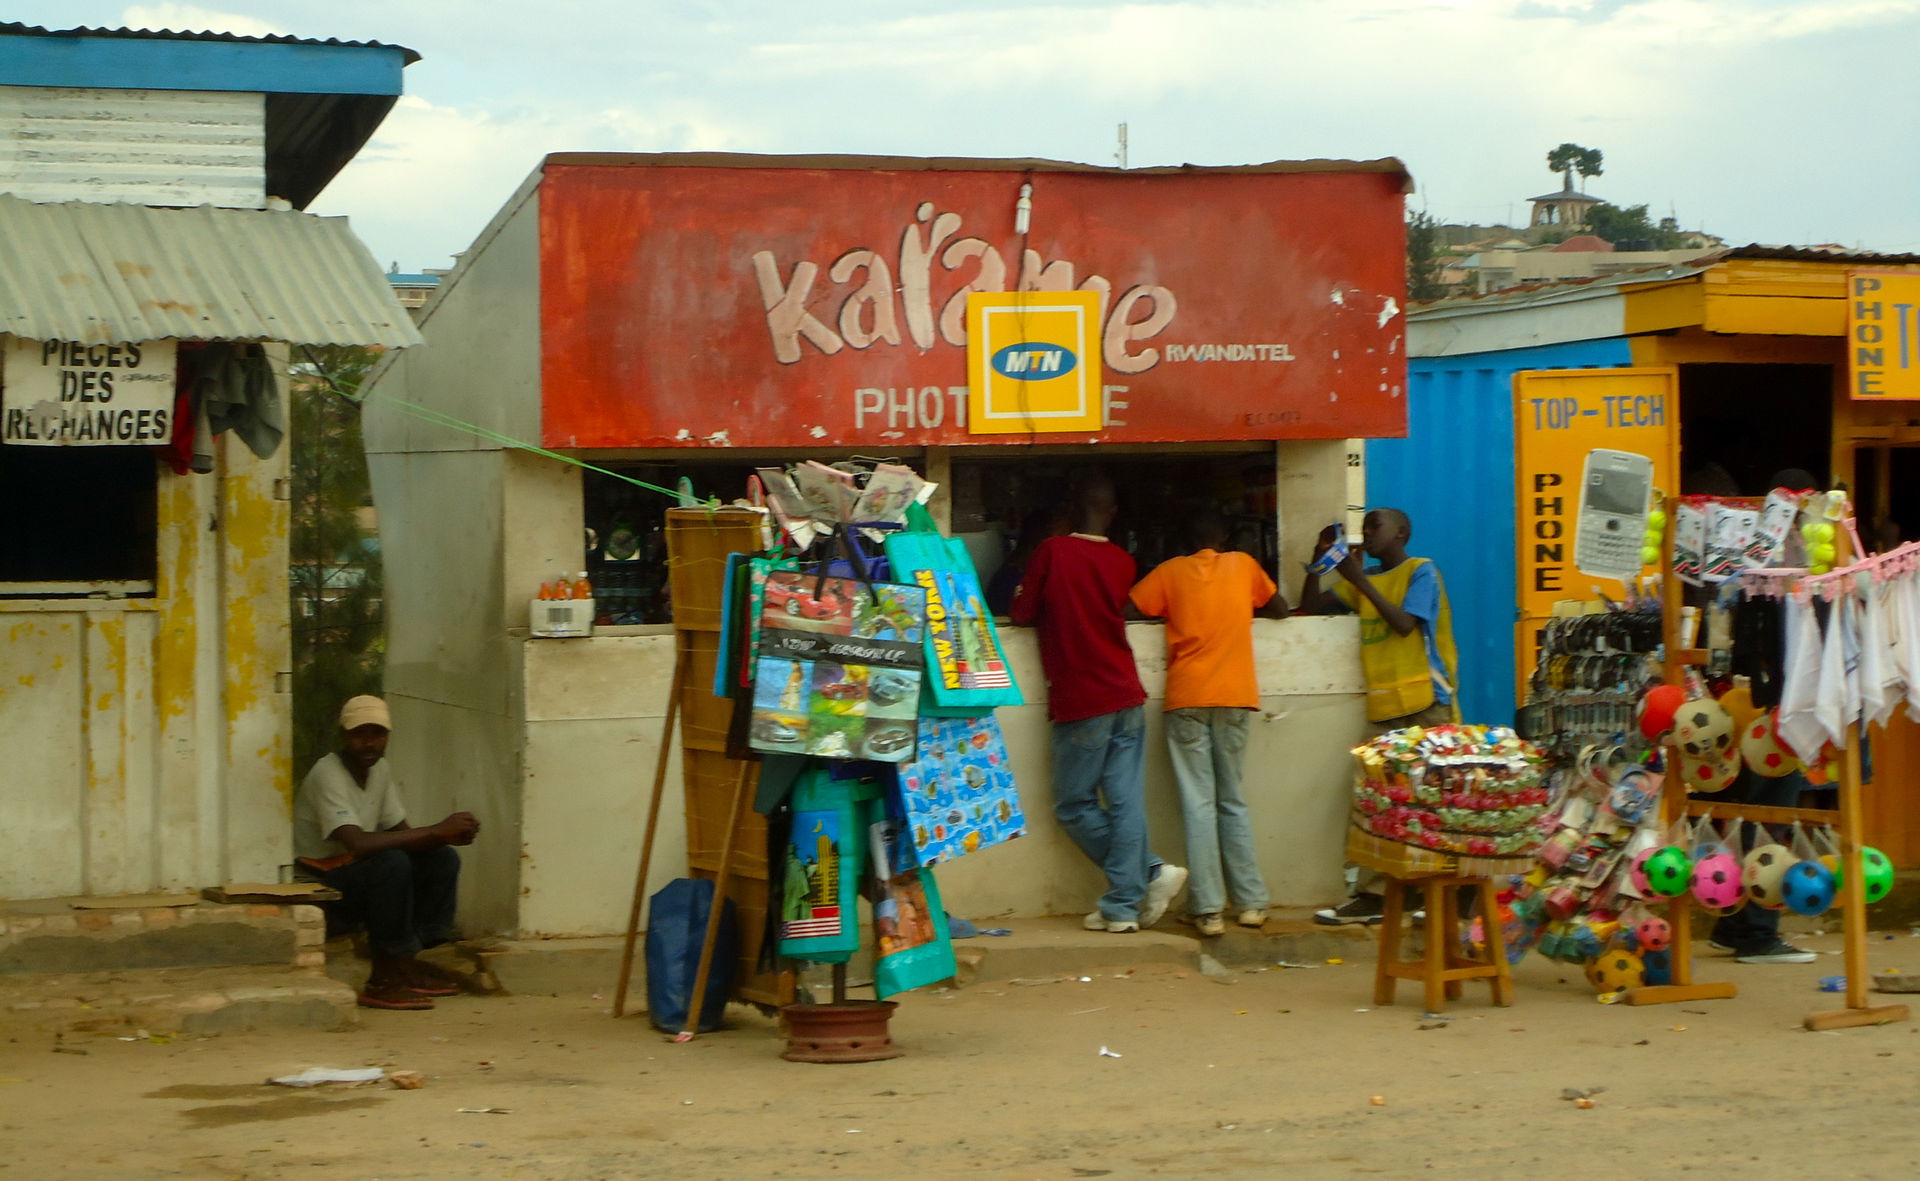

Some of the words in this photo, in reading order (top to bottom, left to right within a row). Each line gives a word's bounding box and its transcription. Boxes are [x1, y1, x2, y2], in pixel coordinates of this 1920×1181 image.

[42, 338, 141, 368] PIECES
[1166, 344, 1296, 362] RWANDATEL
[1855, 277, 1885, 395] PHONE
[1892, 303, 1920, 369] T
[1004, 350, 1063, 373] MTN
[60, 370, 113, 402] DES
[1530, 396, 1665, 430] TOP-TECH
[1534, 473, 1564, 592] PHONE
[915, 569, 947, 636] YORK
[933, 637, 960, 690] NEW
